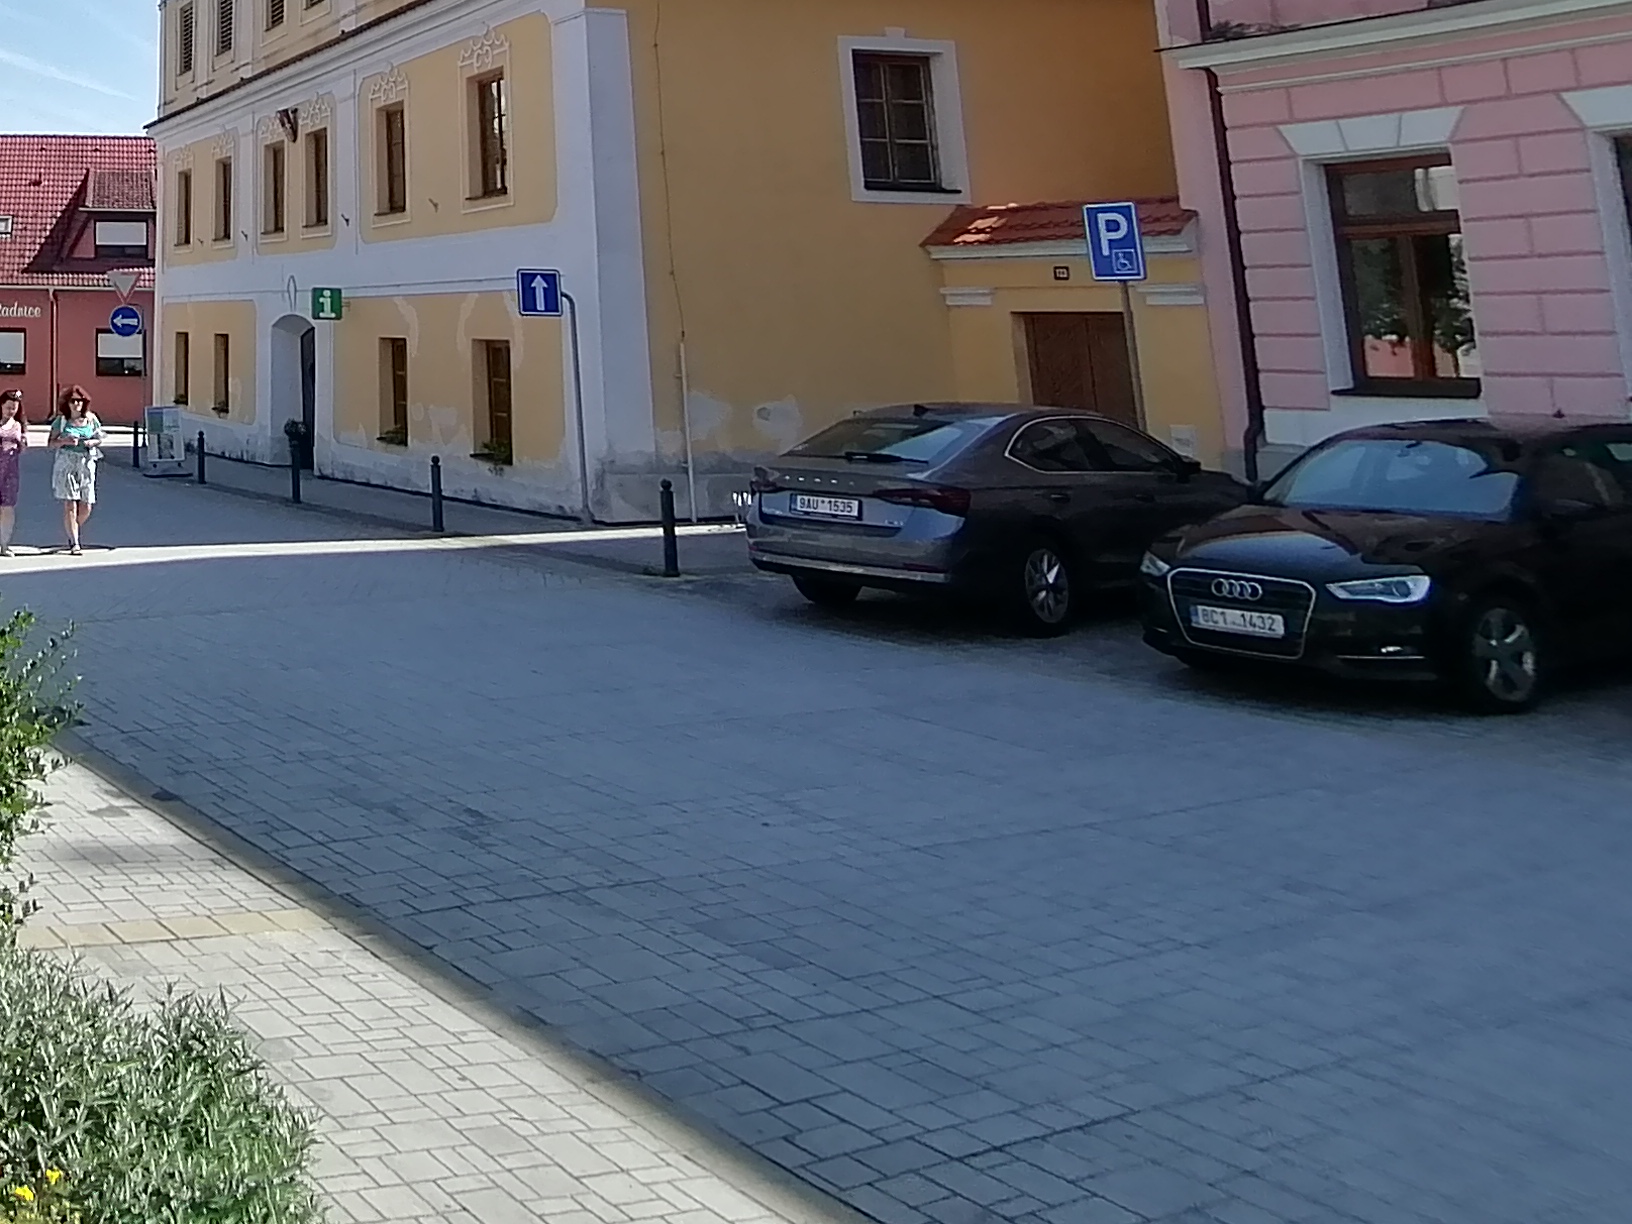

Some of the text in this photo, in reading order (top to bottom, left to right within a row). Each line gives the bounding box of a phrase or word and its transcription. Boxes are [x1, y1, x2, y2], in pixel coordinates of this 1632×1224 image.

[1096, 212, 1128, 256] P
[799, 496, 854, 514] 9AU 1535
[1240, 612, 1276, 632] 1432
